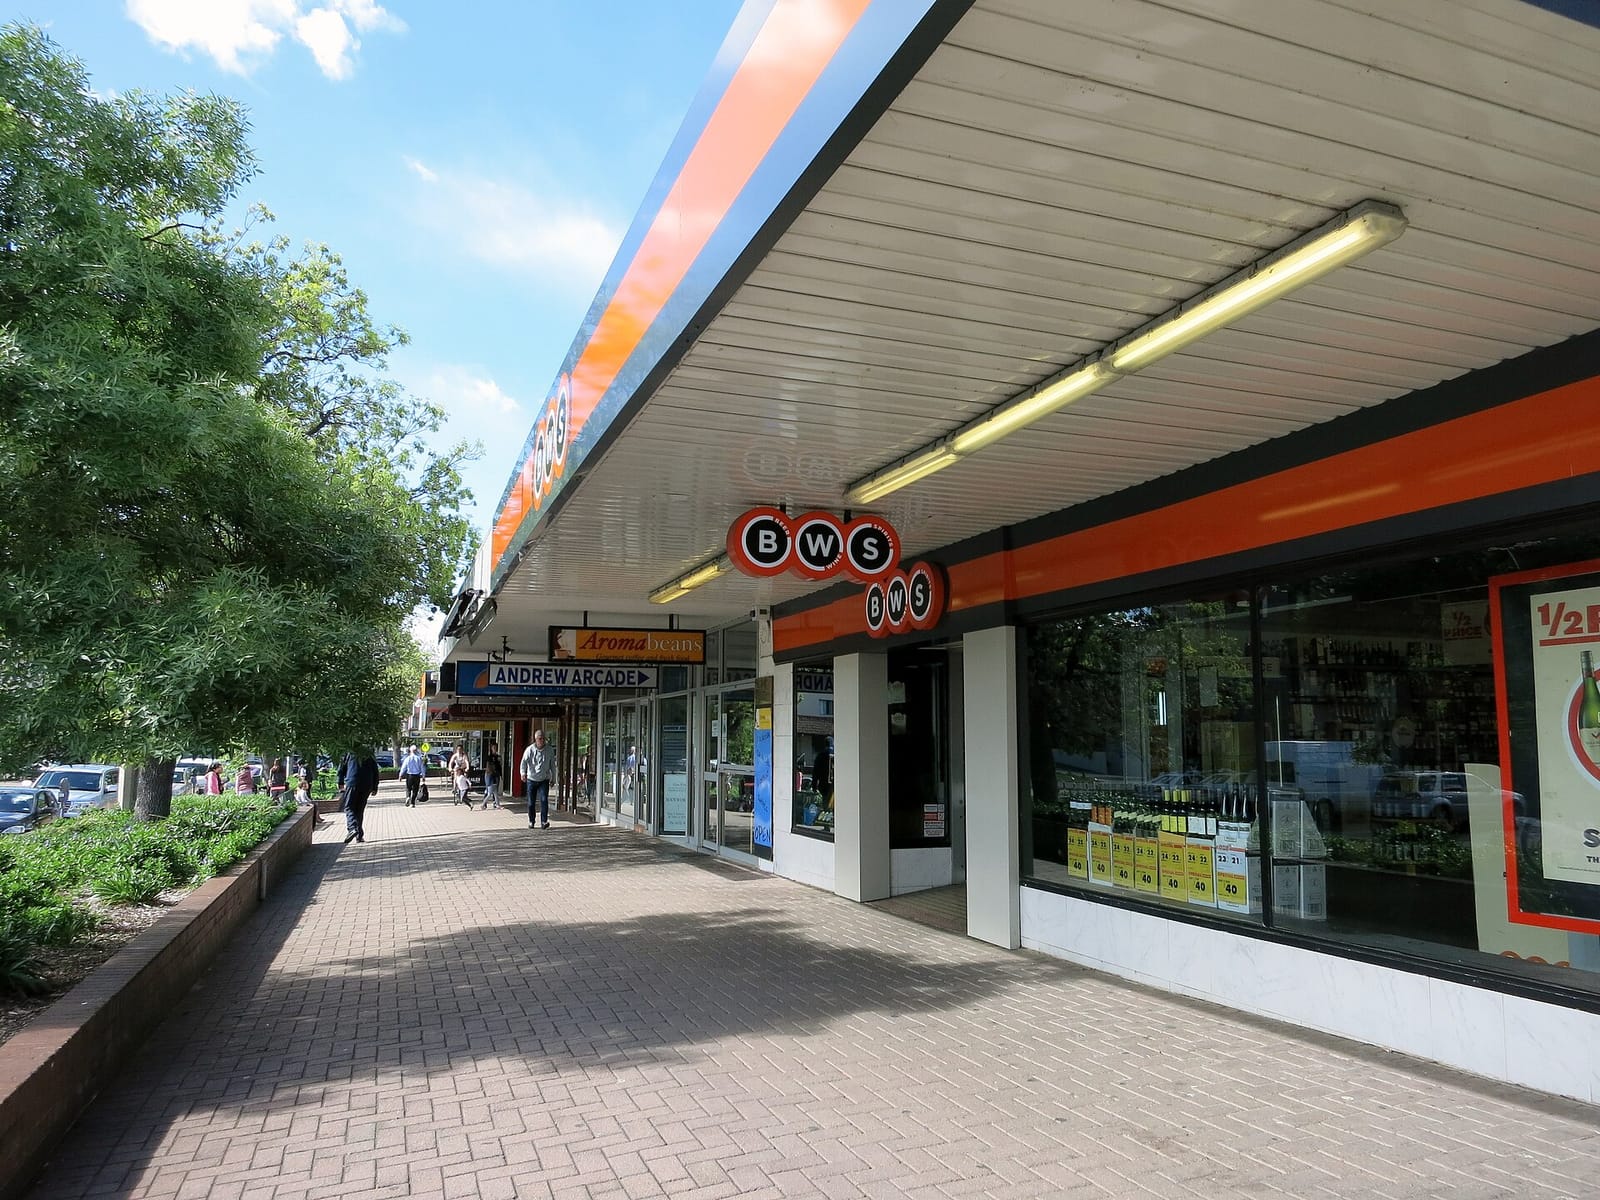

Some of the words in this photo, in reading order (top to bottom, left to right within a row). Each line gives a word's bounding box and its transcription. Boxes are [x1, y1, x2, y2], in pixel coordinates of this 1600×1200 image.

[825, 551, 842, 570] WINE
[495, 667, 569, 685] ANDREW
[571, 669, 638, 687] ARCADE
[1073, 861, 1082, 870] 40
[1096, 863, 1106, 873] 40
[1119, 869, 1128, 879] 40
[1142, 874, 1152, 884] 40
[1168, 878, 1178, 889] 40
[1195, 881, 1206, 892] 40
[1225, 884, 1238, 895] 40
